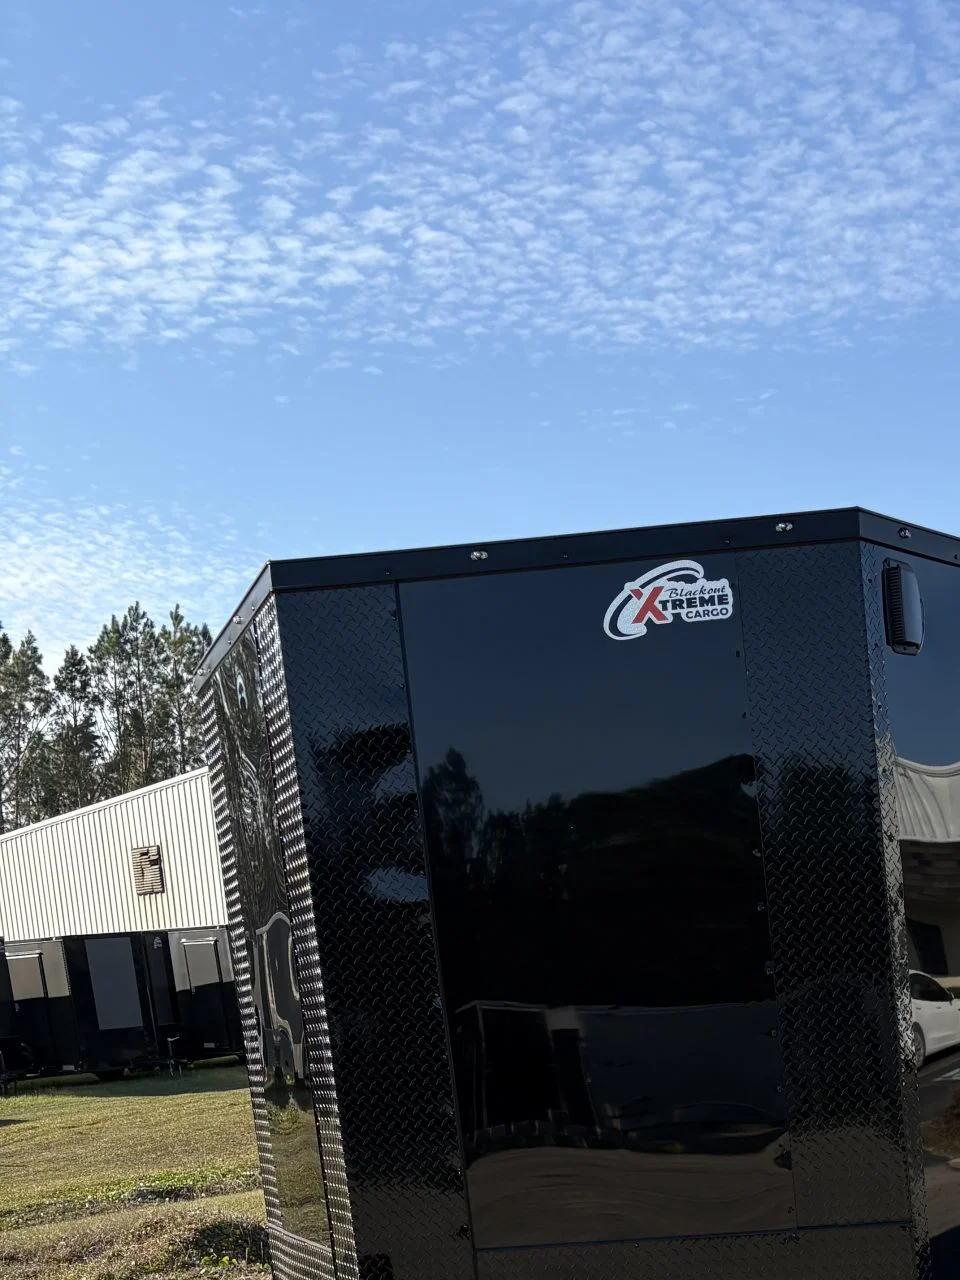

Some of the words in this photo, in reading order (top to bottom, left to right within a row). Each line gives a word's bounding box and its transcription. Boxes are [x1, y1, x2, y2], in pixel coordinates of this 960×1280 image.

[664, 586, 726, 598] Blackout
[630, 586, 729, 624] XTREME
[685, 607, 729, 619] CARGO
